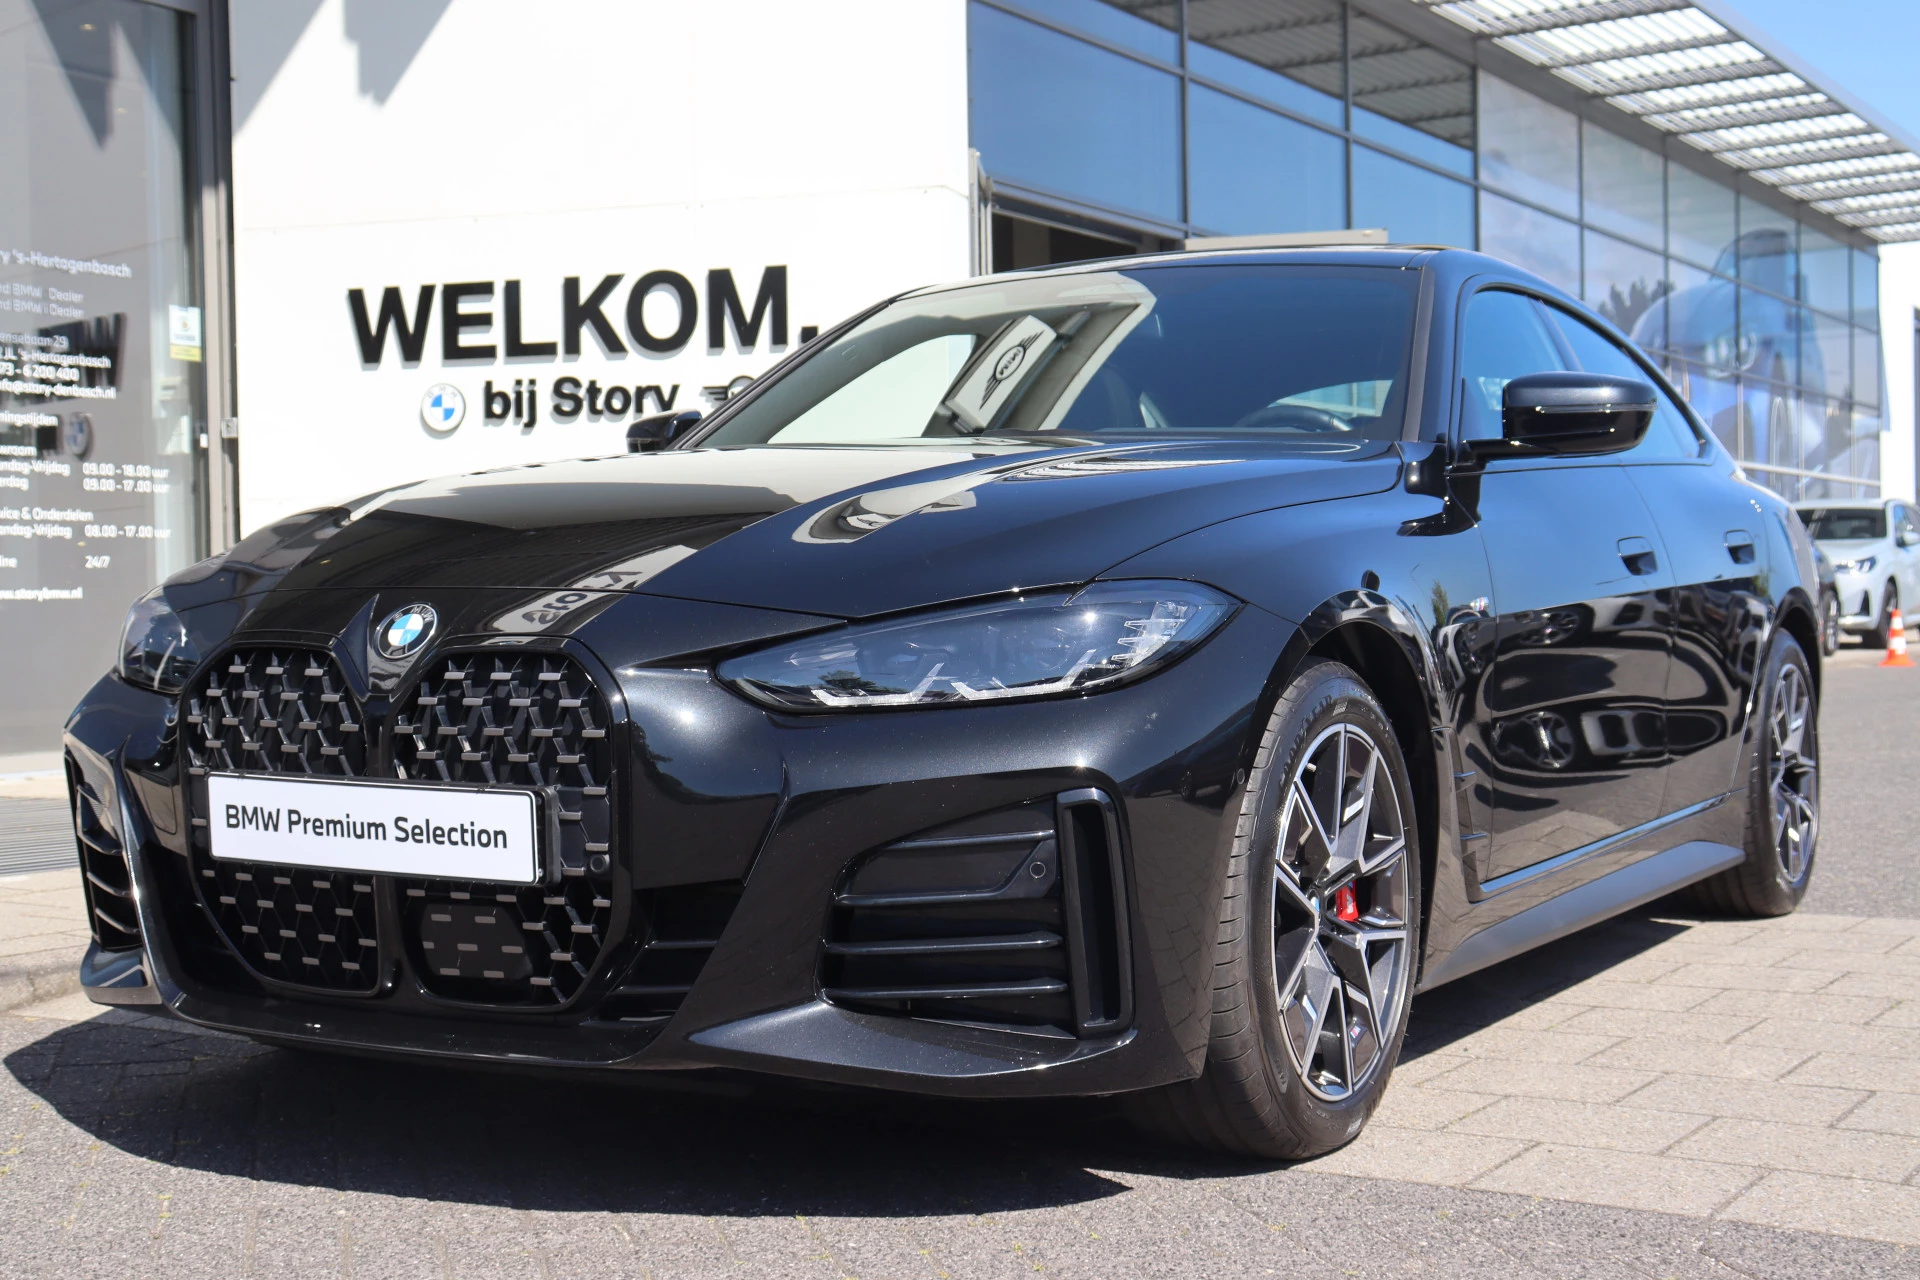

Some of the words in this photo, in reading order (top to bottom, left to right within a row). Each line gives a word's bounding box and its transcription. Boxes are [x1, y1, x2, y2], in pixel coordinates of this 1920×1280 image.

[12, 283, 42, 298] BMW
[48, 287, 84, 303] Dealer
[12, 299, 42, 314] BMW
[49, 303, 84, 319] Dealer
[348, 265, 818, 365] WELKOM.
[53, 335, 69, 349] 29
[23, 364, 32, 377] 6
[33, 365, 55, 379] 200
[57, 367, 80, 381] 400
[485, 380, 537, 428] bij
[21, 507, 31, 520] &
[32, 507, 93, 521] Onderdelen
[85, 555, 110, 569] 24/7
[225, 804, 281, 832] BMW
[287, 809, 387, 841] Premium
[394, 816, 508, 849] Selection
